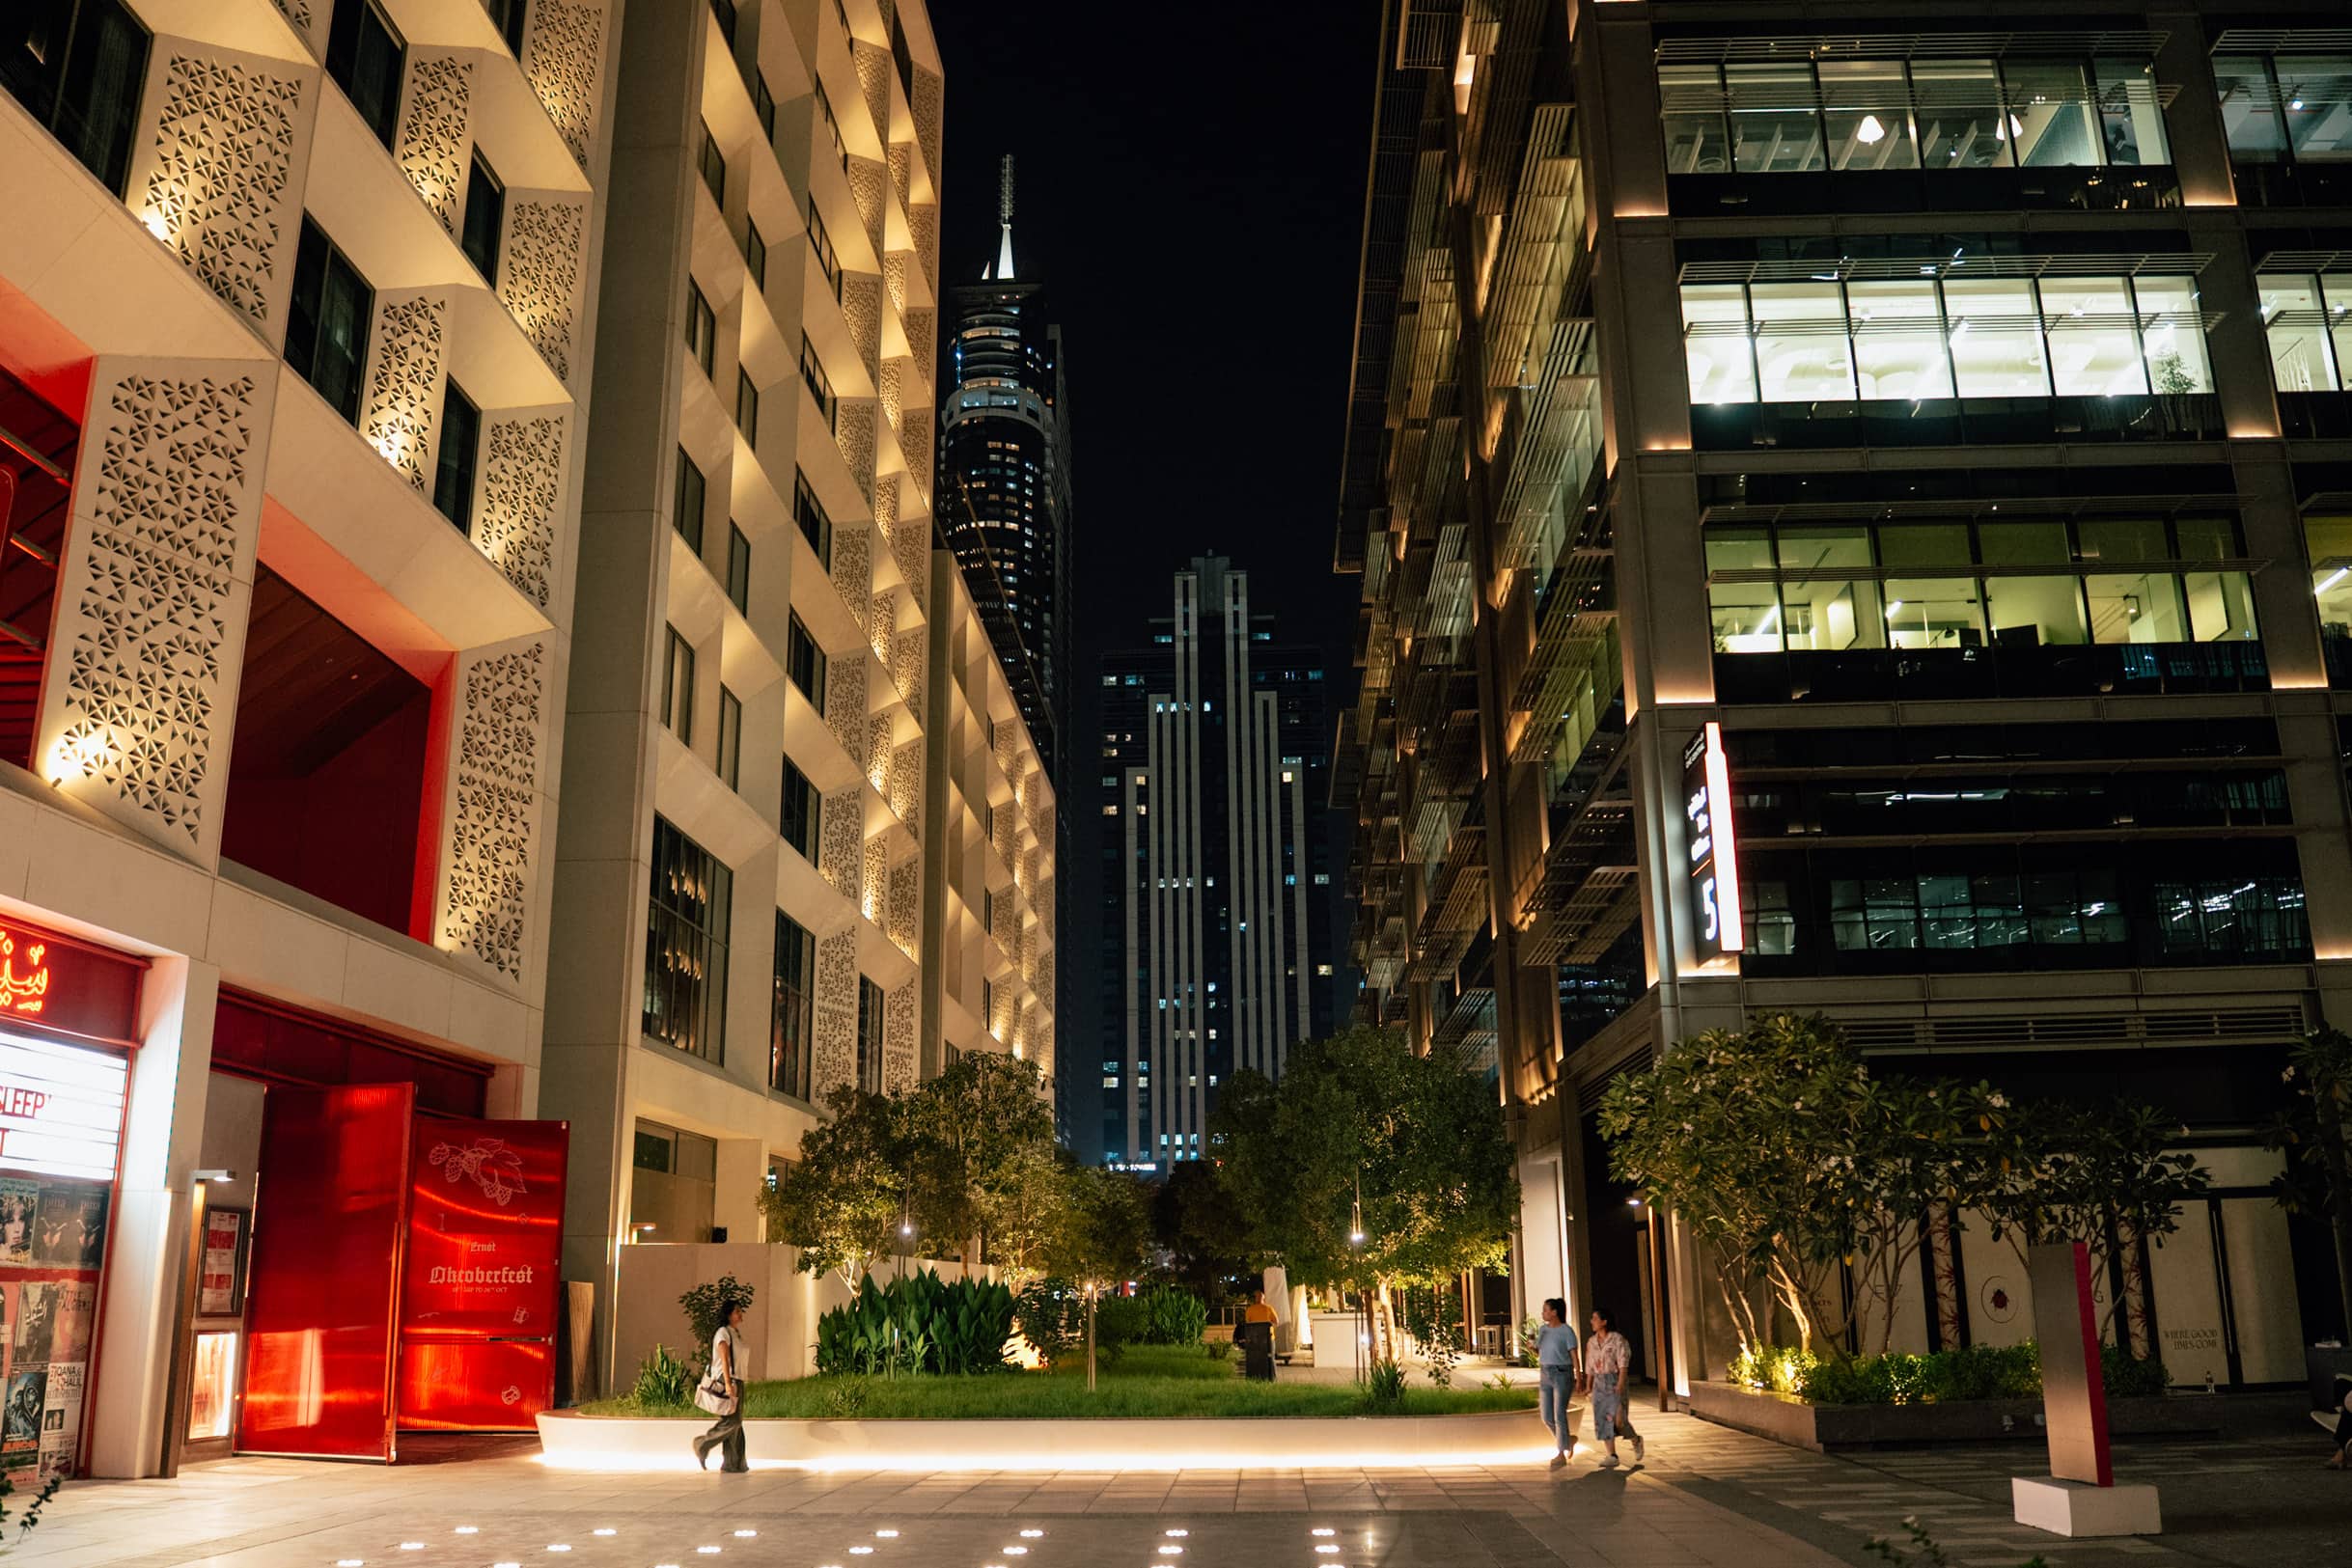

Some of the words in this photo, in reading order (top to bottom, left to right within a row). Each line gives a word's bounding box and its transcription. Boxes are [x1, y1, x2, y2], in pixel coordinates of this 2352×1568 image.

[1702, 877, 1718, 941] 5
[470, 1240, 496, 1252] Ernst
[429, 1265, 533, 1284] Oktoberfest
